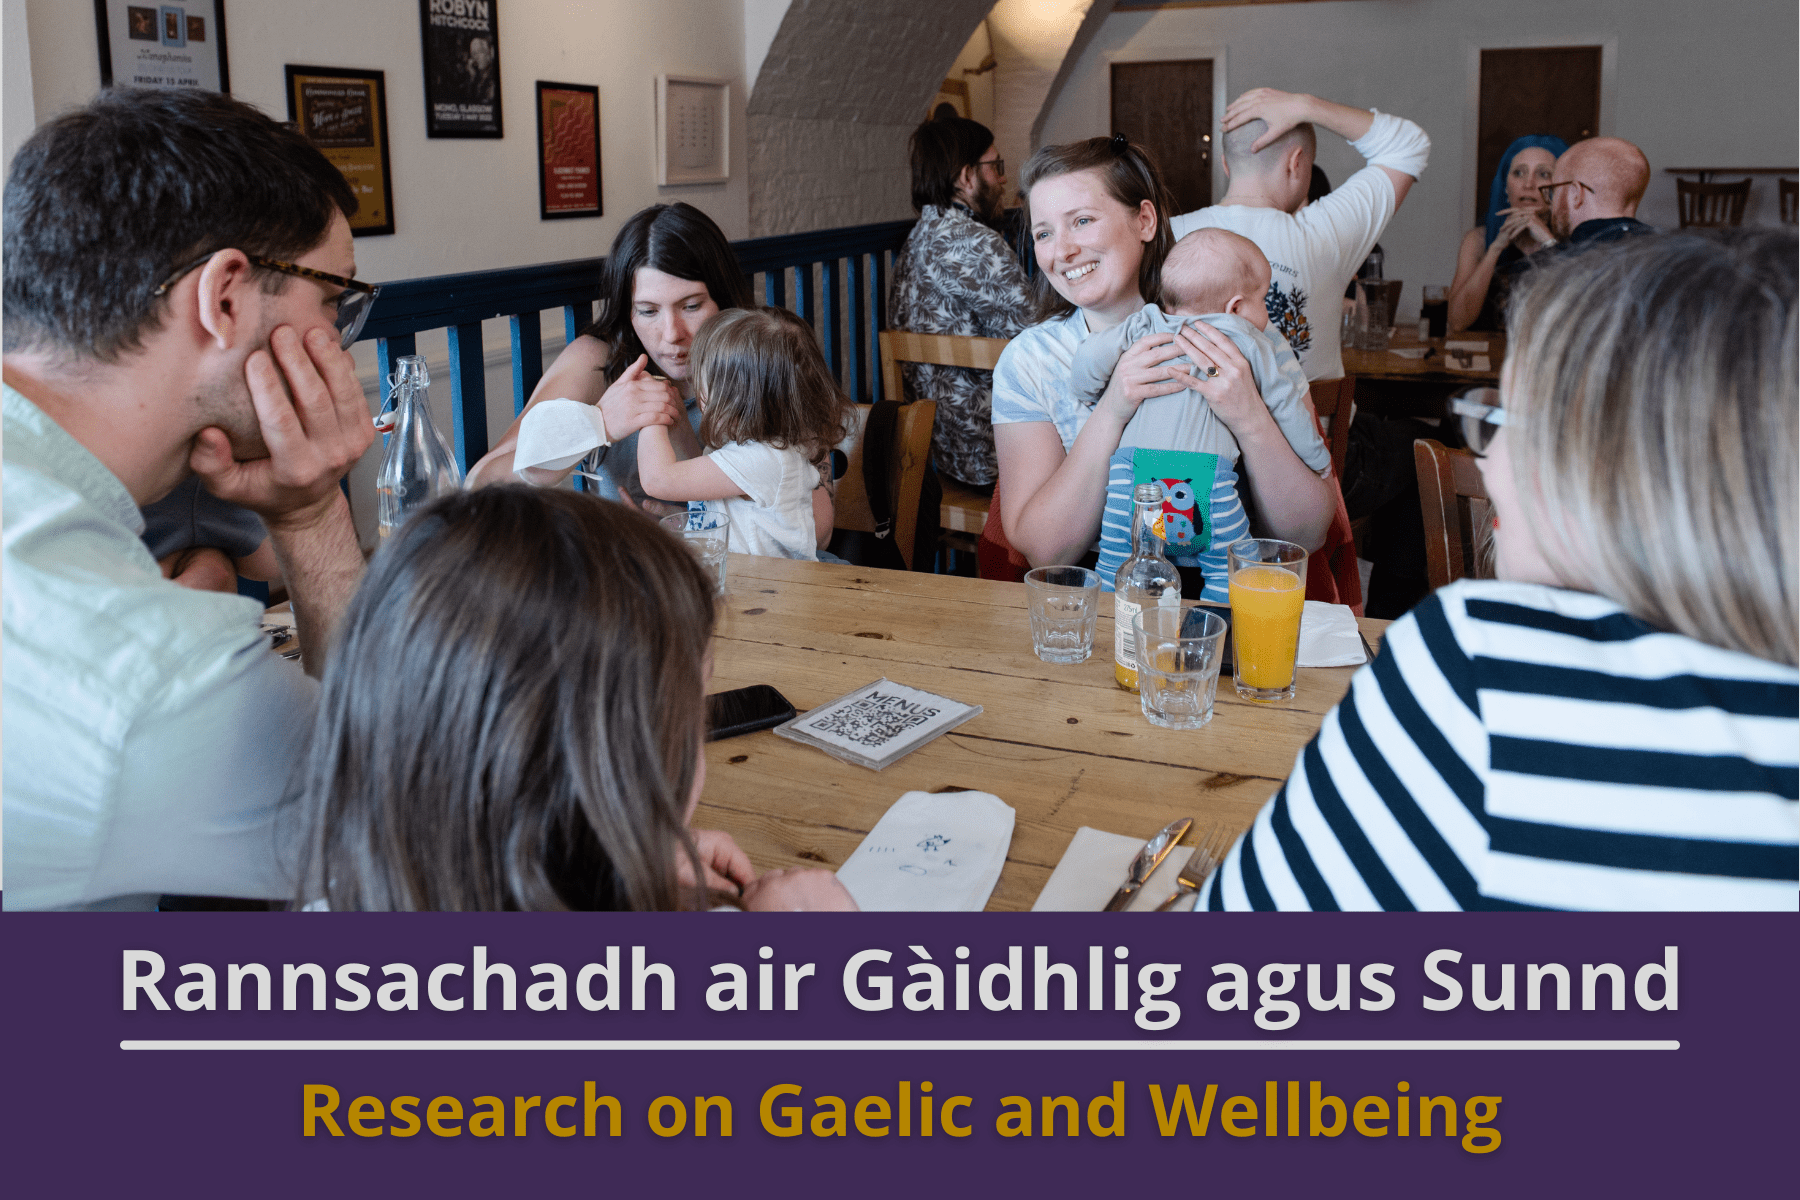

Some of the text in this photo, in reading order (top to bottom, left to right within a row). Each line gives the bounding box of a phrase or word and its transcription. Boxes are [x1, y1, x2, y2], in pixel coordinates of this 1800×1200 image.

[429, 0, 489, 19] ROBYN
[429, 13, 491, 32] HITCHCOCK
[133, 75, 162, 85] FRIDAY
[865, 690, 941, 717] MENUS
